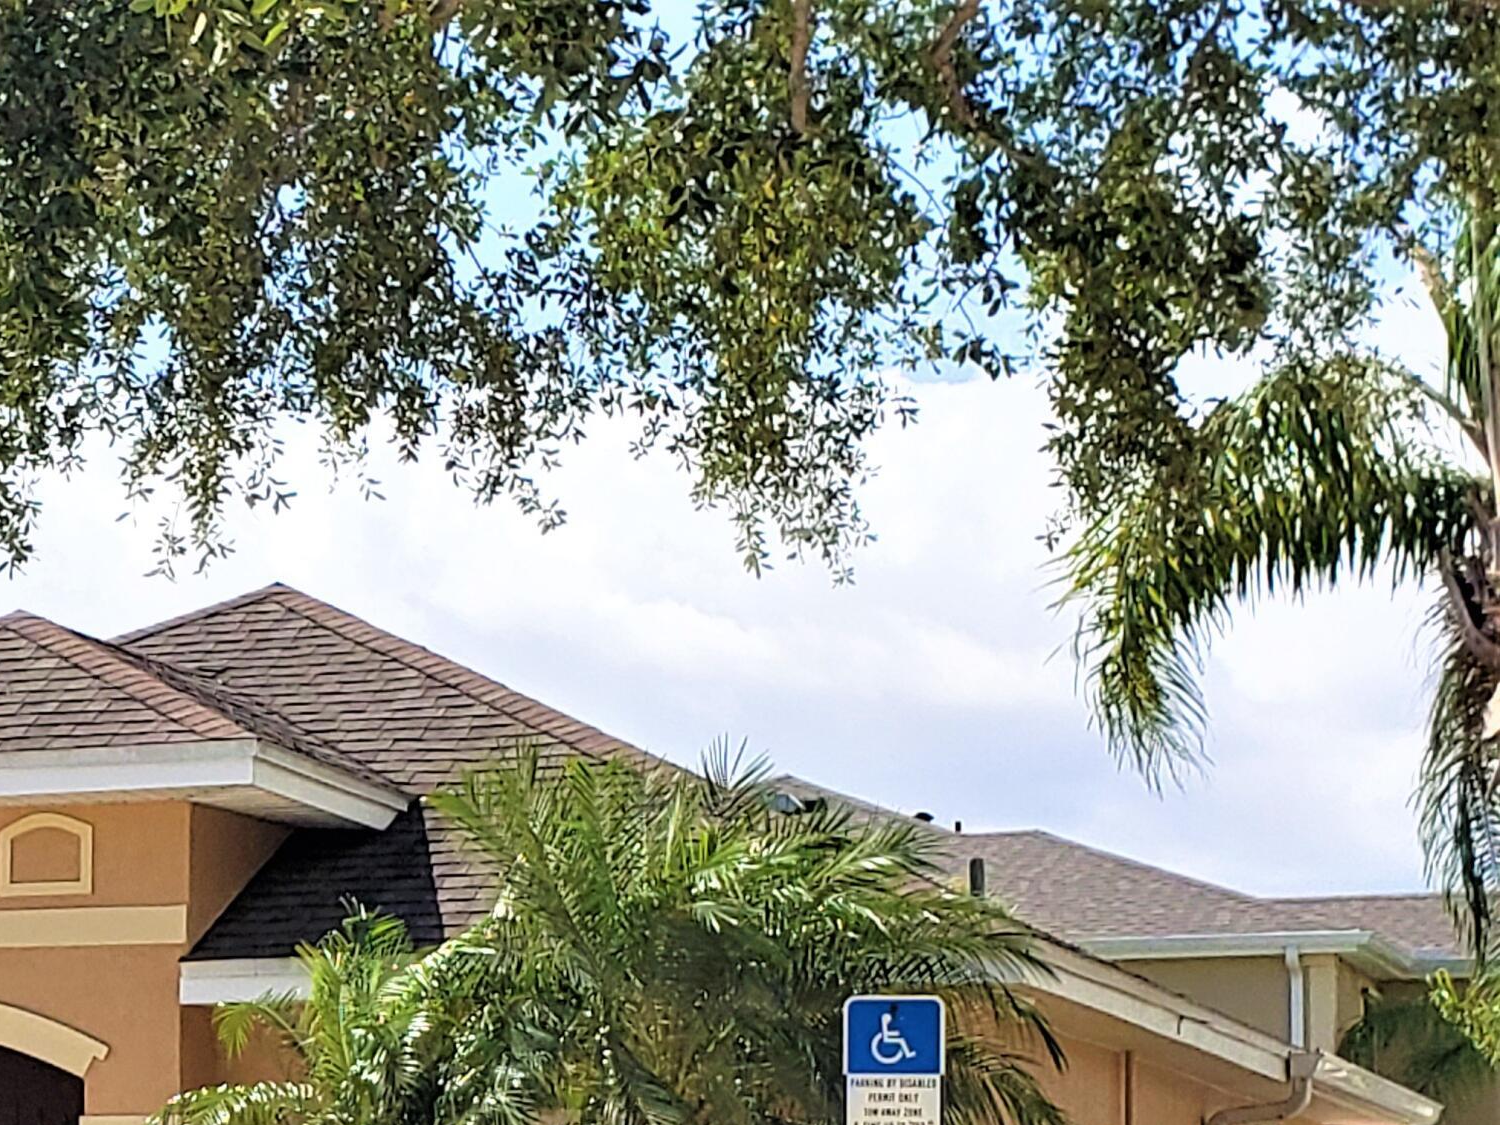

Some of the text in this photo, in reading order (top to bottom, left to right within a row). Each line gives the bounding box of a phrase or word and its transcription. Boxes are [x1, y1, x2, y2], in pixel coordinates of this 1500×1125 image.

[850, 1078, 937, 1088] PARKING BY DISABLED
[868, 1092, 919, 1103] PERMIT ONLY
[864, 1107, 922, 1117] TOW AWAY ZONE
